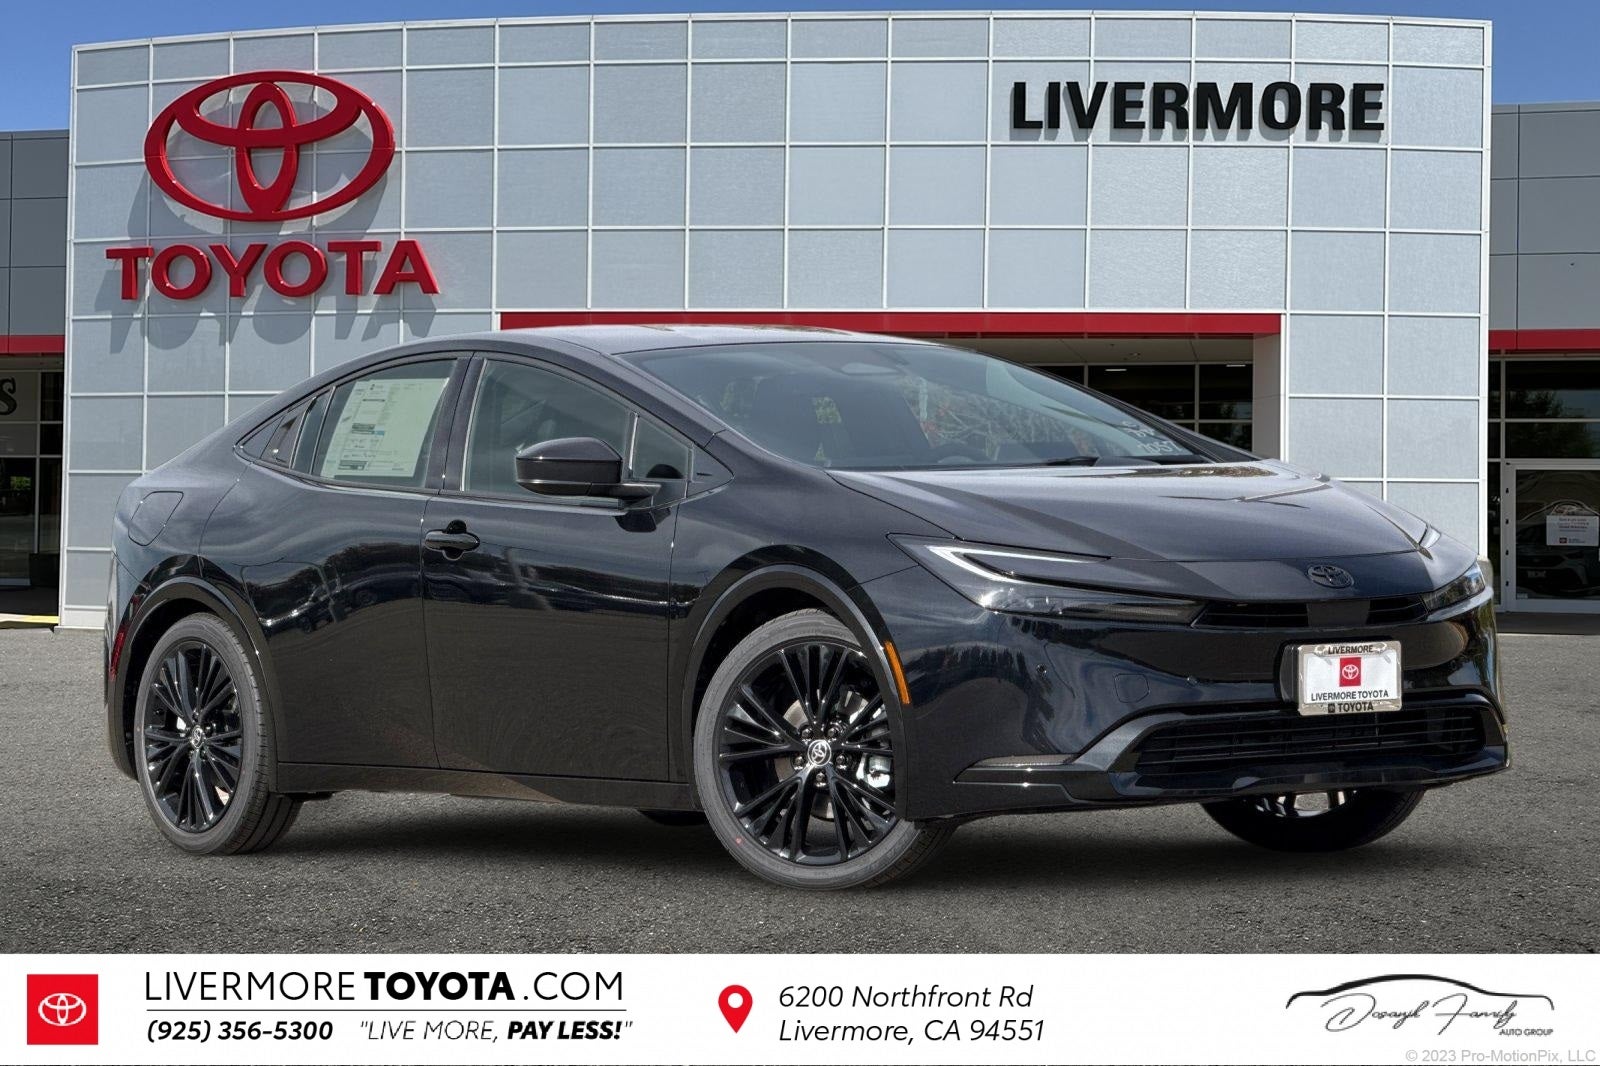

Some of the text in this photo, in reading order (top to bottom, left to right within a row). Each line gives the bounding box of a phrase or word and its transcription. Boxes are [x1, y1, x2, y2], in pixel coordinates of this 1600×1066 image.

[1012, 81, 1384, 130] LIVERMORE
[105, 240, 440, 300] TOYOTA
[1328, 645, 1373, 655] LIVERMORE
[1311, 690, 1389, 701] LIVERMORE TOYOTA
[1338, 702, 1374, 712] TOYOTA
